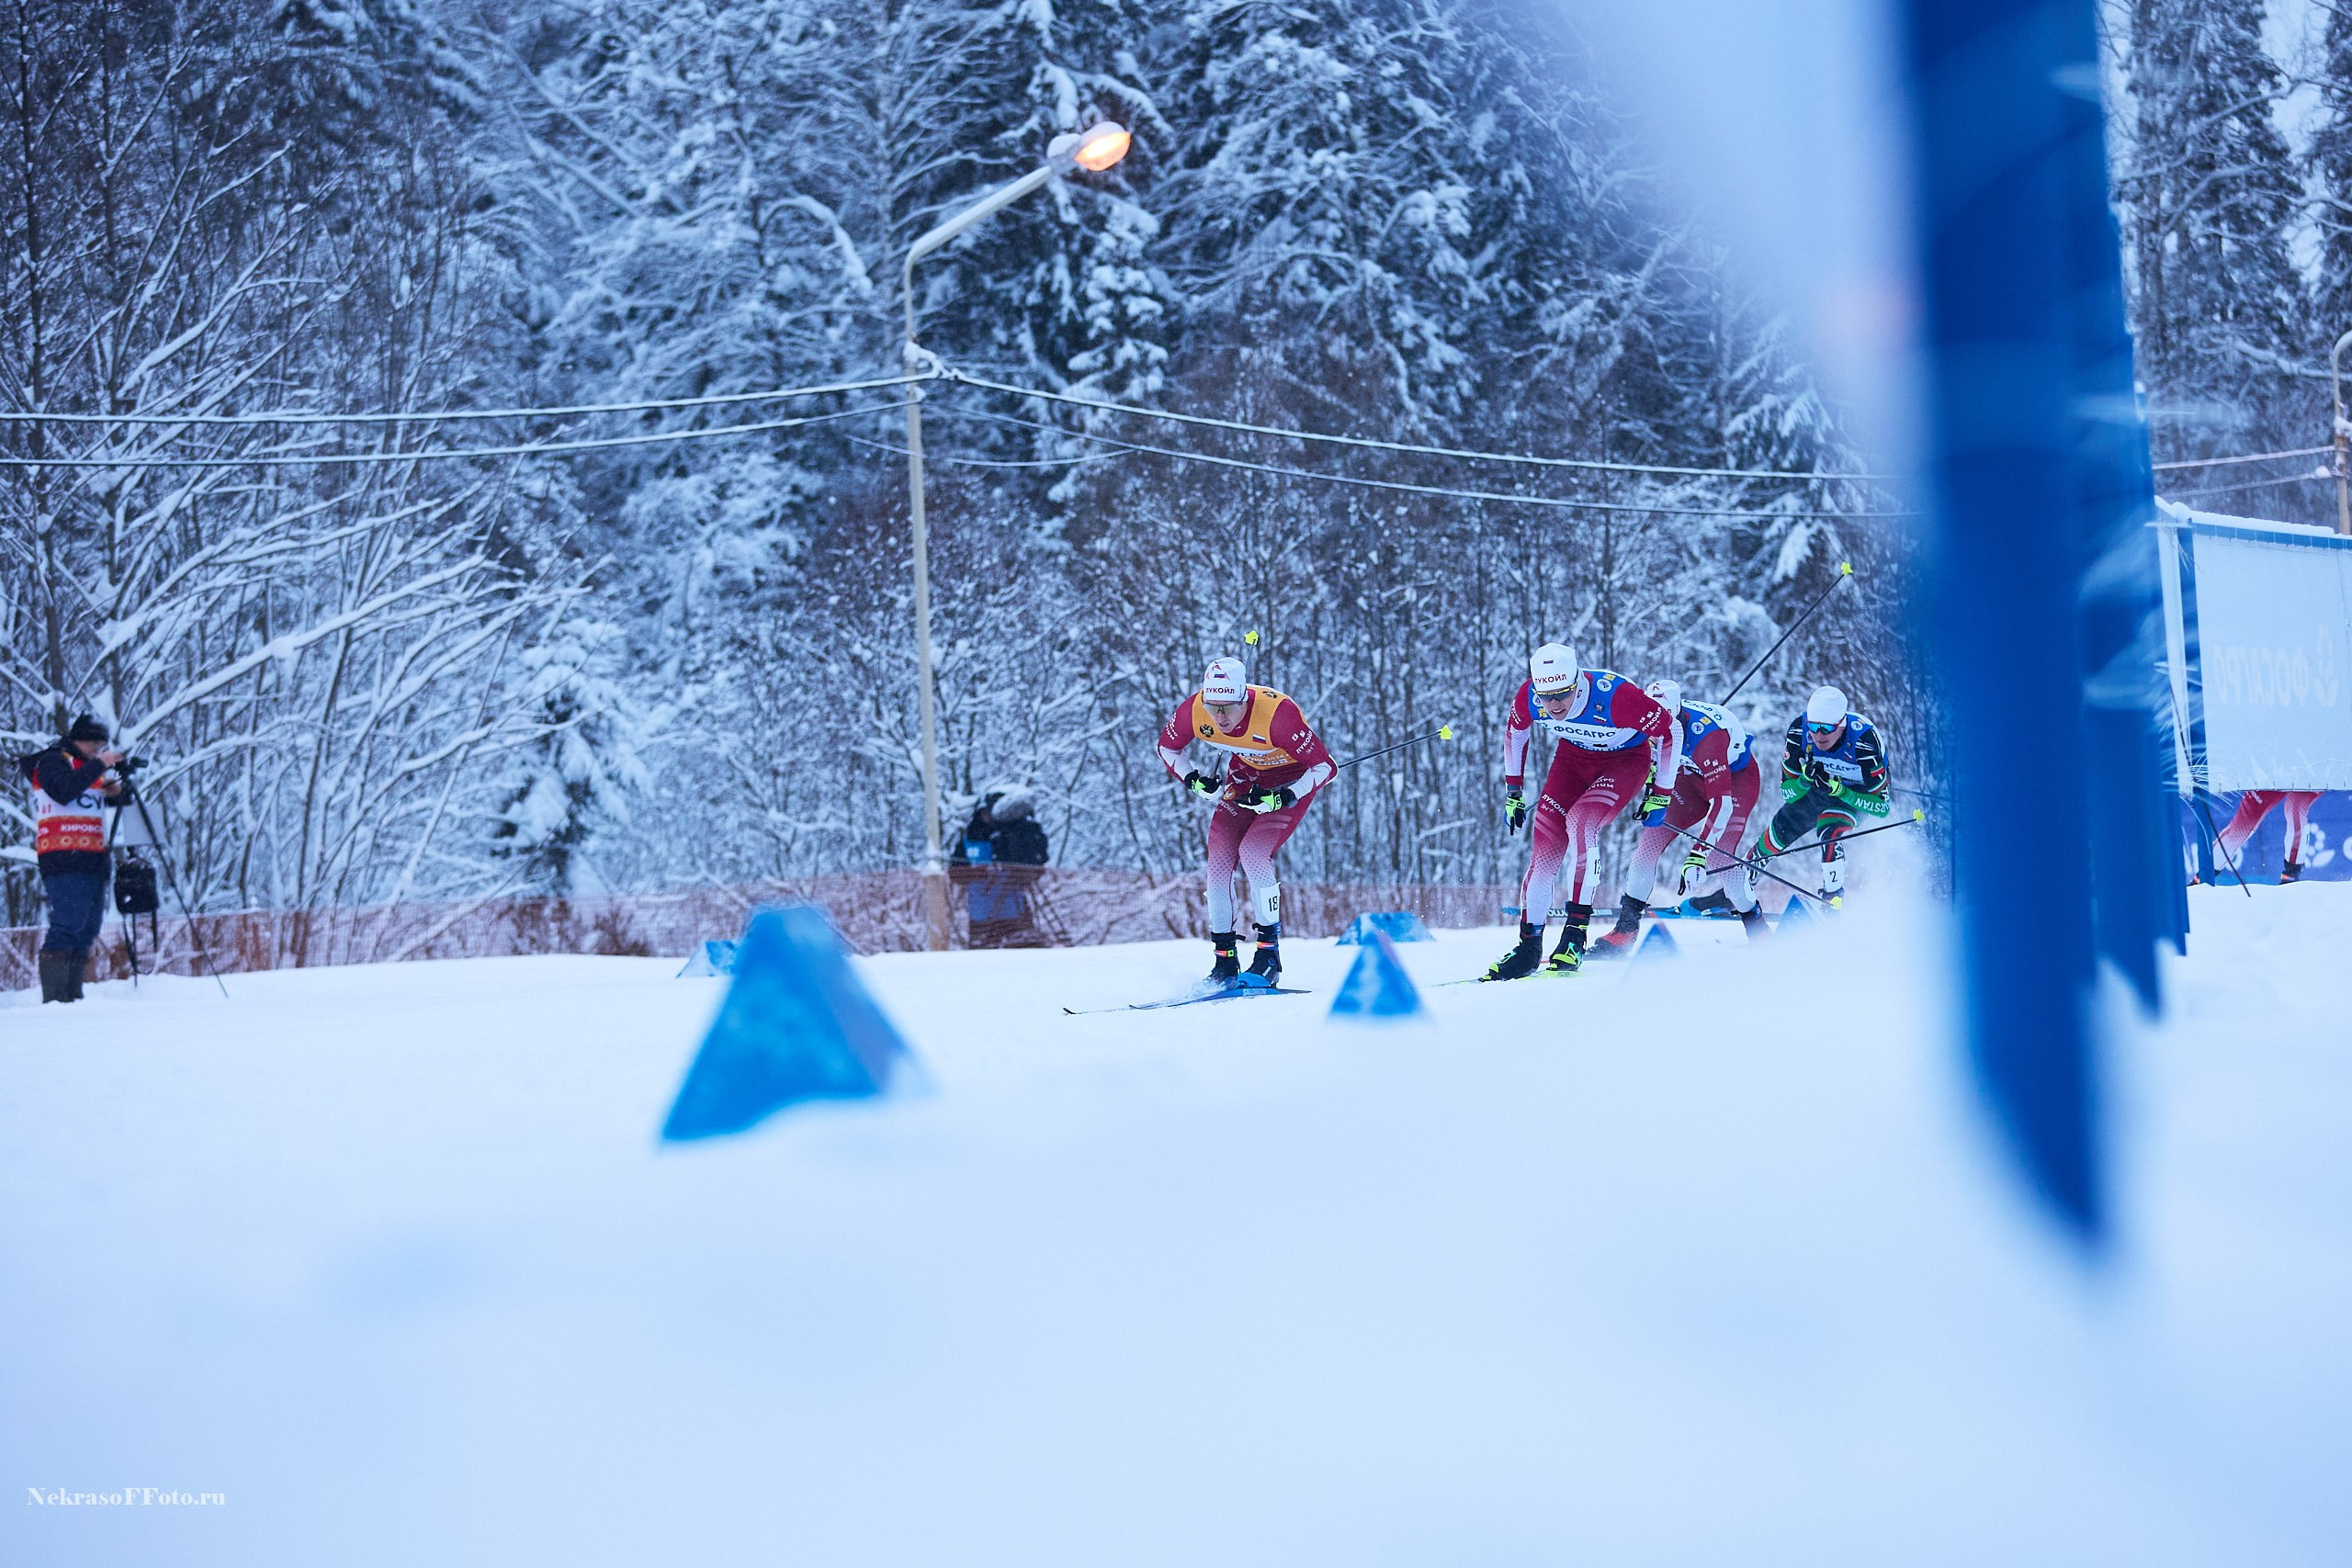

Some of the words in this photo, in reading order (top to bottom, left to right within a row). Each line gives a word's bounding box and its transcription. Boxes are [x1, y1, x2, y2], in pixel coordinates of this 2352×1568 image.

[1534, 673, 1567, 684] ЛУКОЙЛ
[1205, 686, 1235, 694] ЛУКОЙЛ
[1554, 726, 1616, 739] ФОСАГРО
[1829, 870, 1838, 883] 2
[1268, 895, 1278, 912] 18
